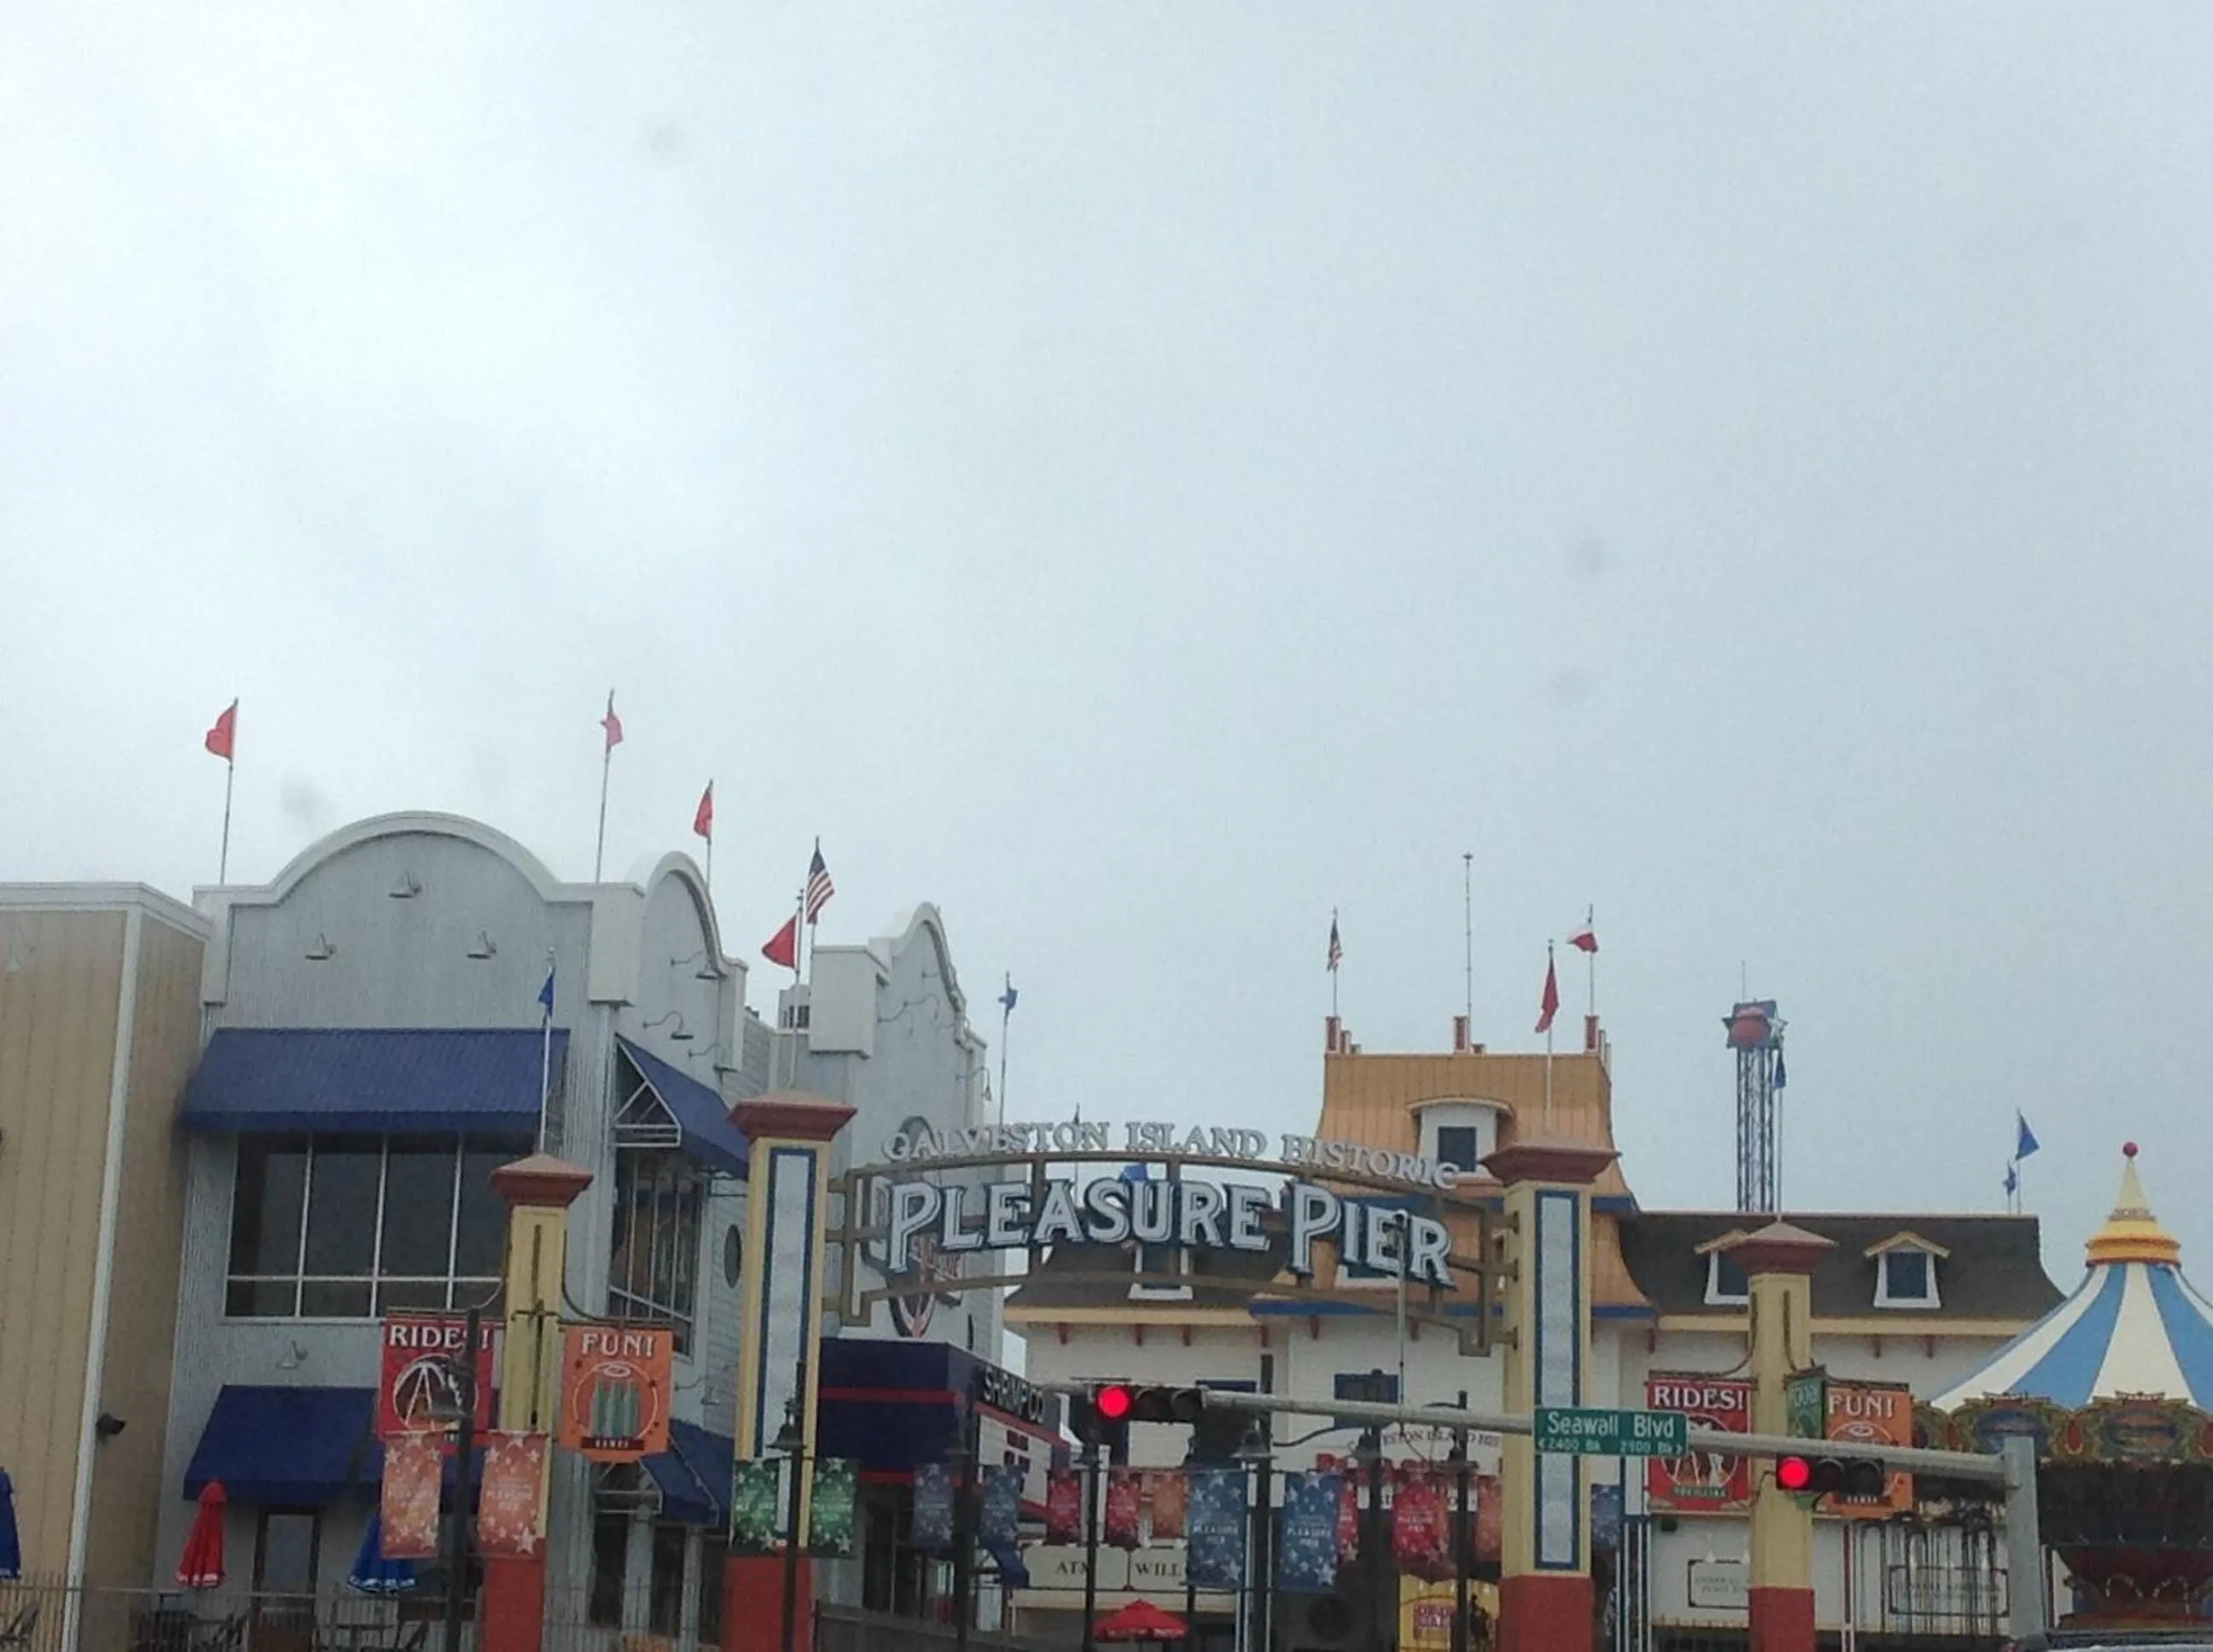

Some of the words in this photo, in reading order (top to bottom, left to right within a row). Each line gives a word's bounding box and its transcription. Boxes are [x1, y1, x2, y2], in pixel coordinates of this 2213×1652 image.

[881, 1122, 1110, 1162] GALVESTON
[1125, 1122, 1267, 1159] ISLAND
[1281, 1134, 1460, 1189] HISTORIC
[888, 1175, 1271, 1274] PLEASURE
[1291, 1181, 1452, 1286] PIER
[581, 1332, 656, 1357] FUN!
[1654, 1385, 1744, 1410] RIDES!
[1828, 1392, 1895, 1418] FUN!
[1547, 1411, 1618, 1436] Seawall
[1633, 1413, 1674, 1439] Blvd
